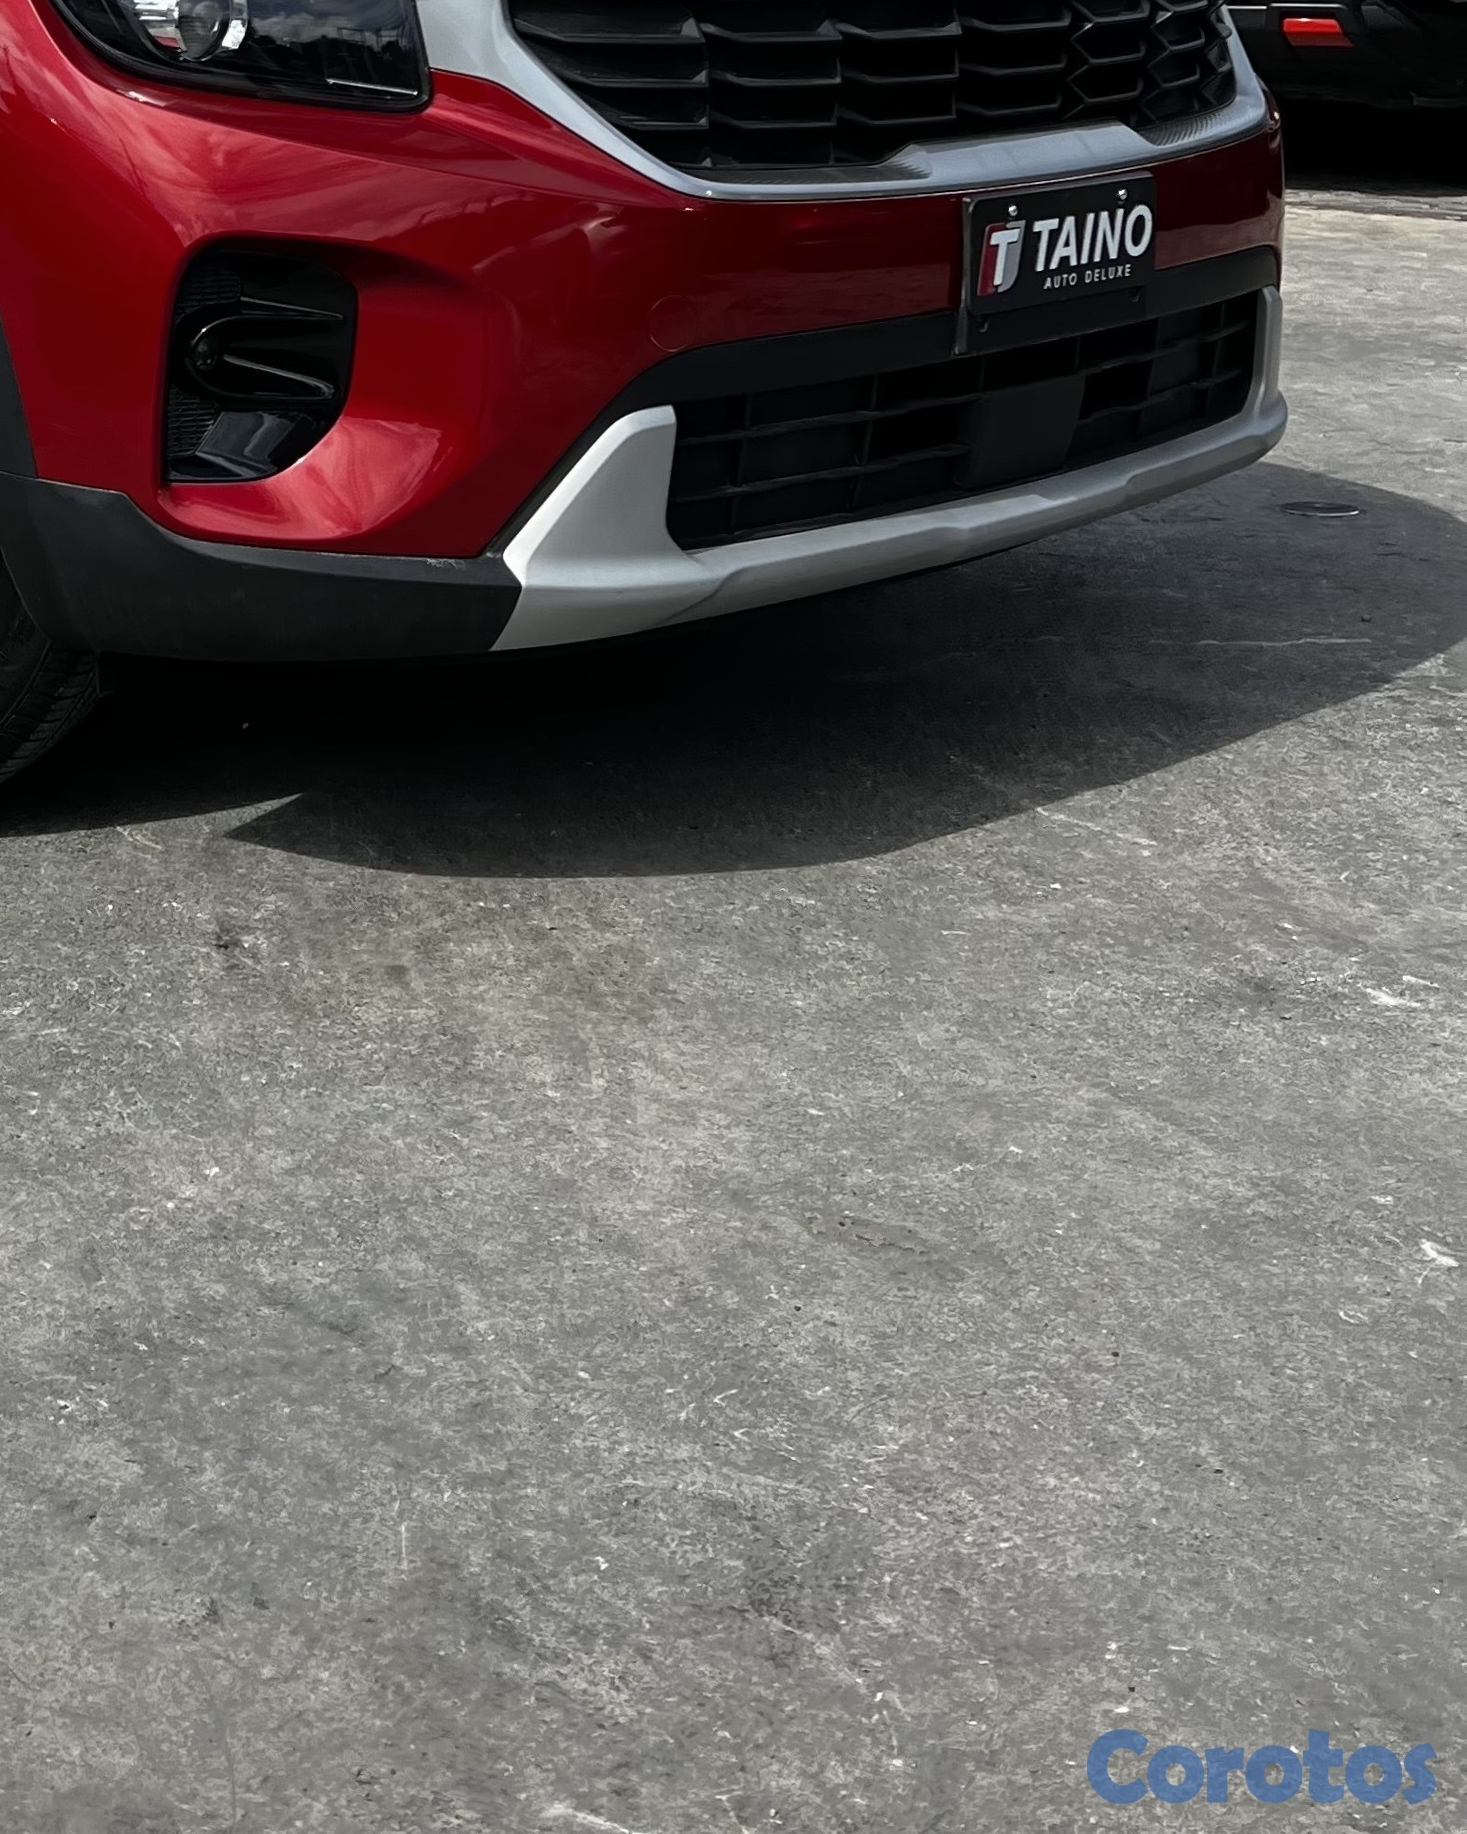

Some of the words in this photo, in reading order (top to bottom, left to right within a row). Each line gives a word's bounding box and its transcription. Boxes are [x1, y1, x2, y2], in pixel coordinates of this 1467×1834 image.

[1033, 204, 1153, 272] TAINO
[1043, 276, 1077, 290] AUTO
[1085, 264, 1132, 284] DELUXE
